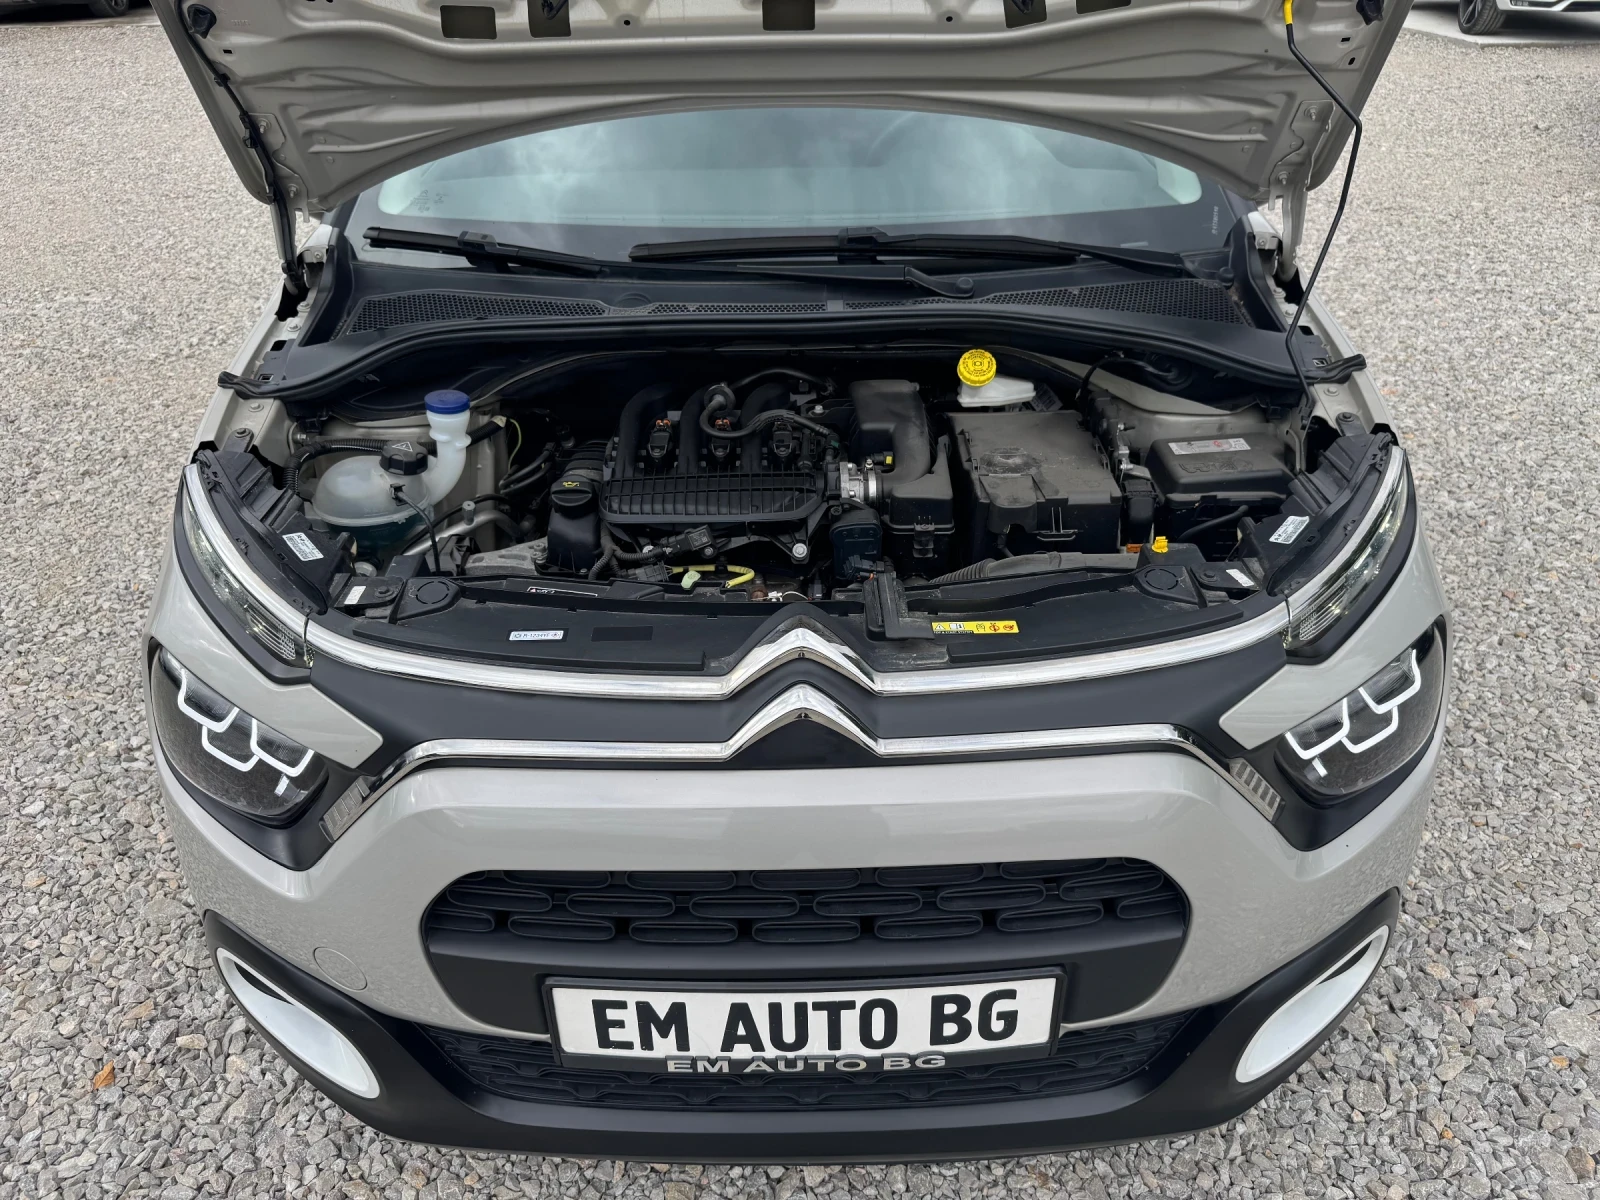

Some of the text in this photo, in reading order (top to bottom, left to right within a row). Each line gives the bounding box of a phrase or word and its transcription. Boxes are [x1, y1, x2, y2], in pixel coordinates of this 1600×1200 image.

[592, 988, 1018, 1052] EM AUTO BG
[666, 1054, 945, 1073] EM AUTO BG
